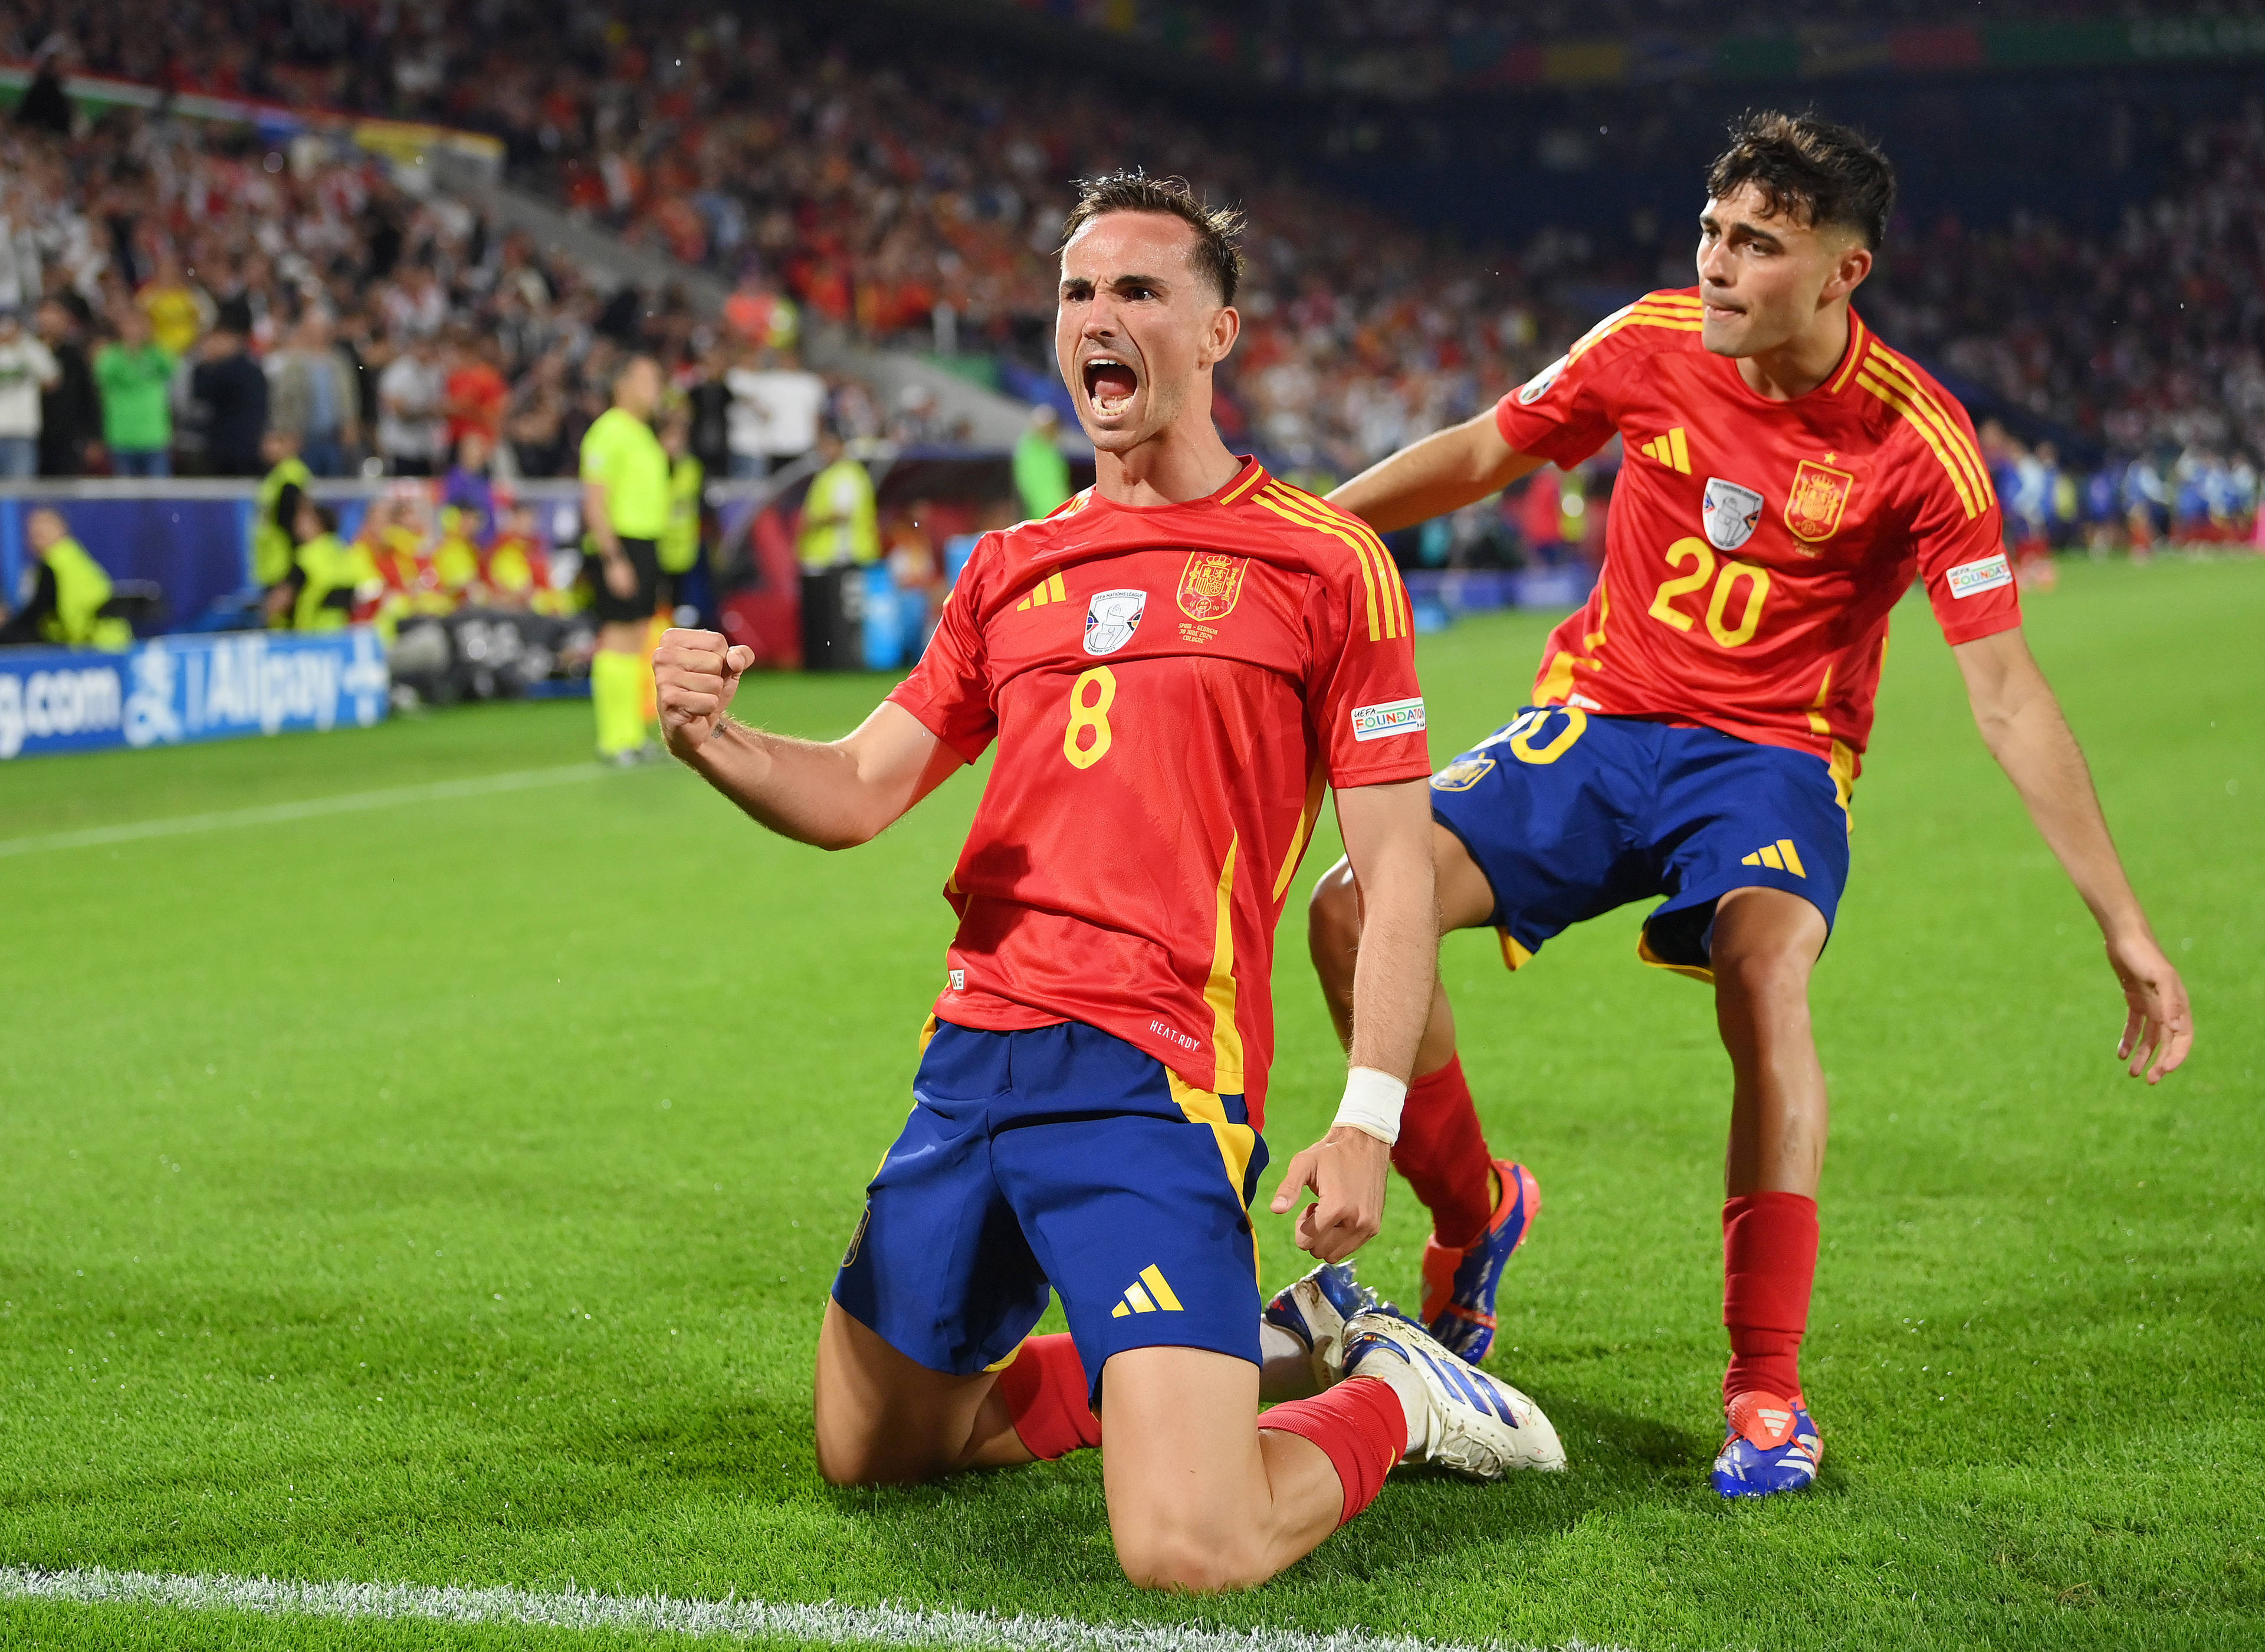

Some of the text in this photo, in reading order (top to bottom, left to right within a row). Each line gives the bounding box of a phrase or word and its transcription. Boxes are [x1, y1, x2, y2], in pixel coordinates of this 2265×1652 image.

[1648, 537, 1770, 648] 20
[1197, 625, 1218, 635] GEORGIA
[1183, 635, 1205, 644] COLOGNE
[1199, 632, 1213, 641] 2024
[1063, 665, 1117, 770] 8
[1354, 708, 1376, 718] UEFA
[1149, 1019, 1200, 1052] HEAT.RDY
